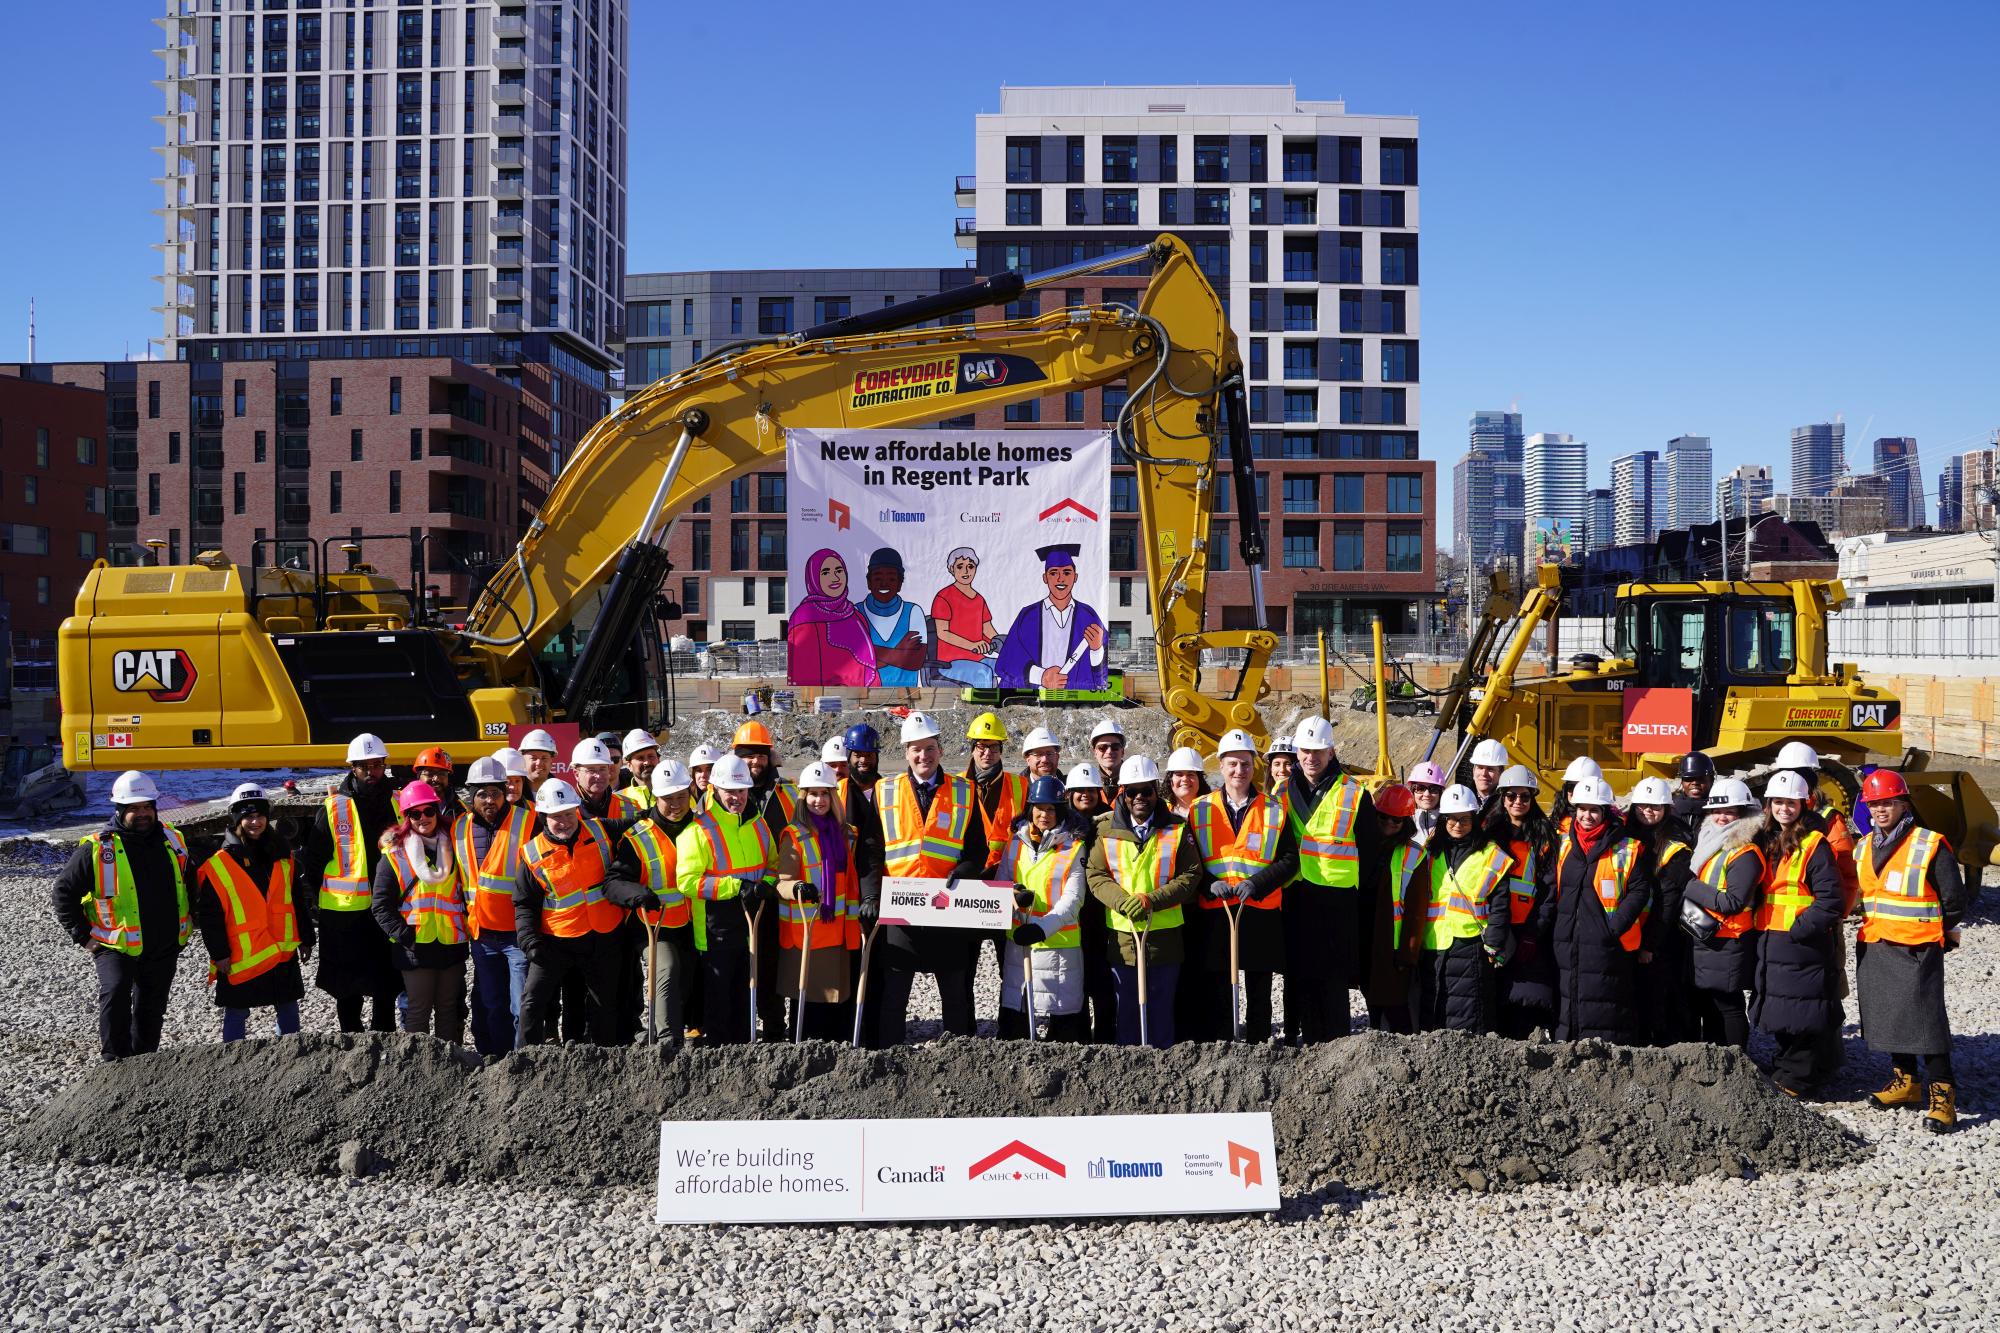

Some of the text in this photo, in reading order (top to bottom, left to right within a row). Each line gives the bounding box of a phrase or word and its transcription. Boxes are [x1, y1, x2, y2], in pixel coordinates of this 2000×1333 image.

[854, 358, 955, 394] COREYDALE
[963, 359, 998, 382] CAT
[853, 380, 953, 408] CONTRACTING CO.
[820, 440, 1073, 462] New affordable homes
[864, 465, 1030, 491] in Regent Park
[891, 510, 925, 523] TORONTO
[960, 512, 1001, 523] Canada
[114, 651, 177, 691] CAT
[1607, 680, 1625, 690] D6T
[1789, 707, 1843, 720] COREYDALE
[1852, 704, 1887, 727] CAT
[485, 723, 507, 735] 352
[1627, 723, 1688, 736] DELTERA
[1785, 720, 1840, 728] CONTRACTING CO.
[891, 896, 926, 906] HOMES
[954, 898, 1000, 909] MAISONS
[736, 1148, 815, 1171] building
[1184, 1161, 1223, 1169] Community
[877, 1165, 945, 1184] Canada
[1107, 1160, 1163, 1178] TORONTO
[675, 1174, 850, 1194] affordable homes.
[982, 1172, 1050, 1182] CMHC SCHL
